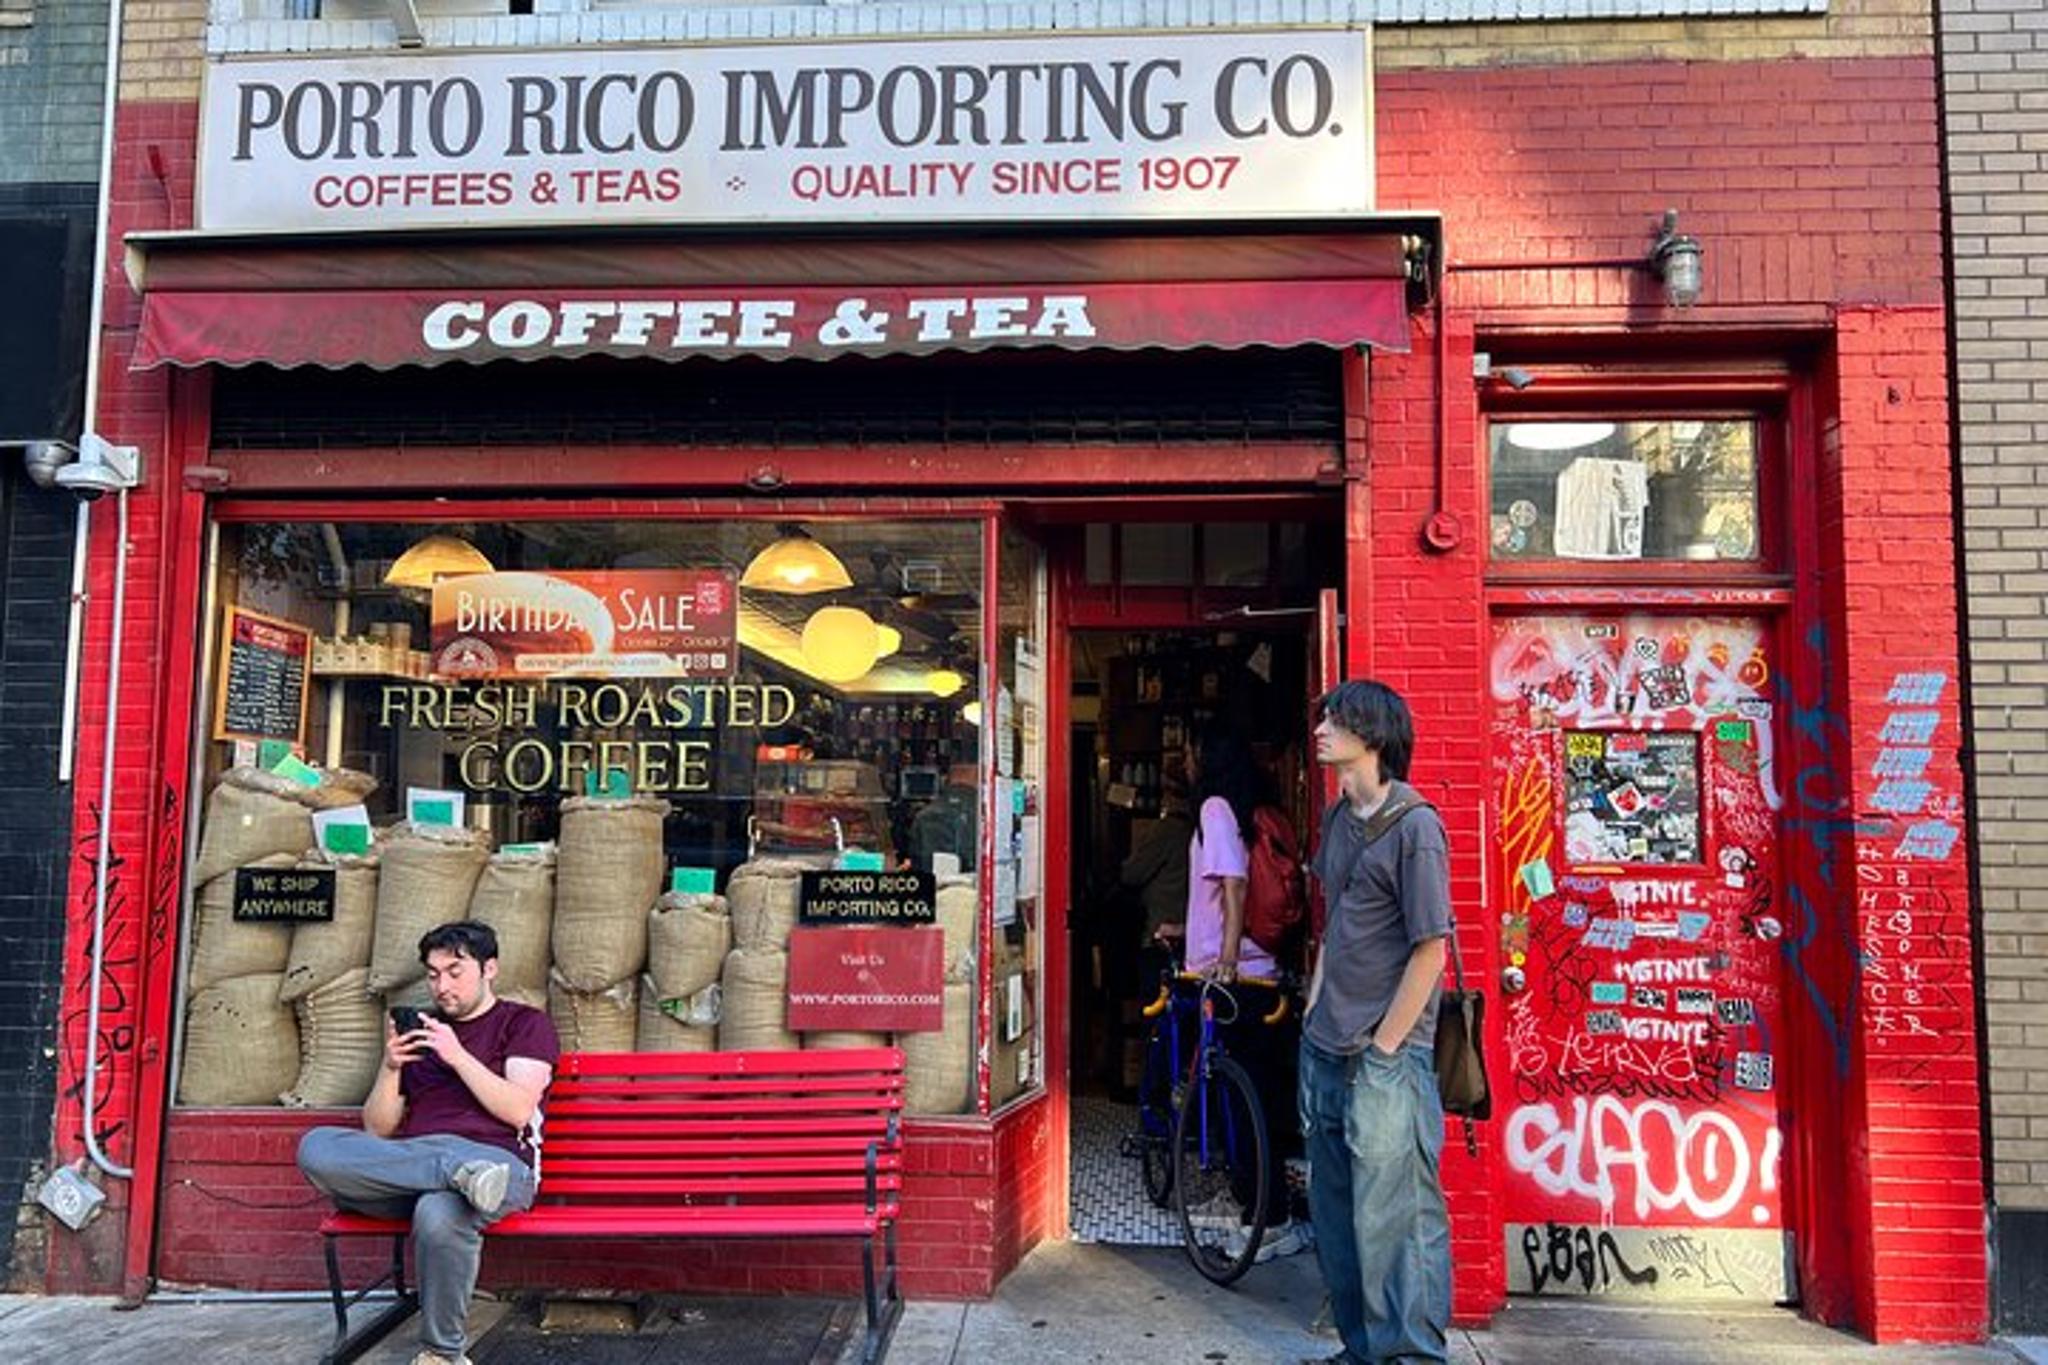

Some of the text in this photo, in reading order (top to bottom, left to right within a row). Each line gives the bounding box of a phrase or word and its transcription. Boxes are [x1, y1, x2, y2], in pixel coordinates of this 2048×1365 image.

[233, 54, 1343, 160] PORTO RICO IMPORTING CO.
[315, 169, 681, 208] COFFEES & TEAS
[792, 156, 1241, 201] QUALITY SINCE 1907
[423, 296, 1096, 352] COFFEE & TEA
[457, 590, 607, 633] BIRTHDA
[379, 684, 795, 730] FRESH ROASTED
[460, 738, 711, 793] COFFEE
[252, 876, 319, 892] WE SHIP
[819, 875, 919, 893] PORTO RICO
[239, 899, 328, 917] ANYWHERE
[807, 901, 899, 917] IMPORTING
[841, 954, 885, 966] Visit Us
[790, 994, 940, 1006] WWW.PORTORICO.COM
